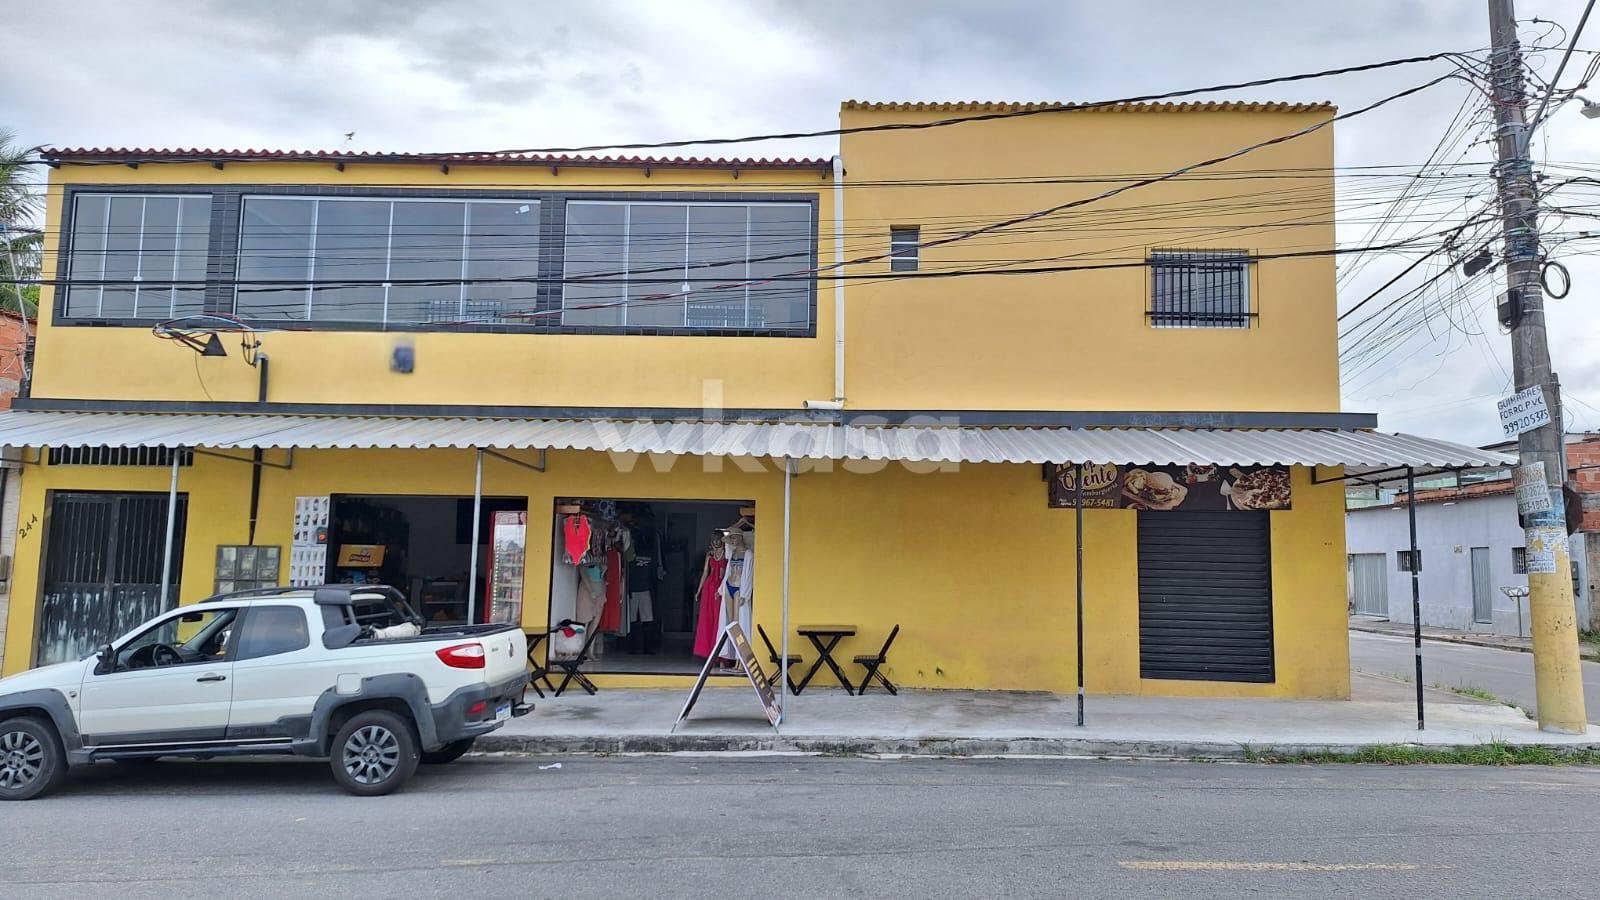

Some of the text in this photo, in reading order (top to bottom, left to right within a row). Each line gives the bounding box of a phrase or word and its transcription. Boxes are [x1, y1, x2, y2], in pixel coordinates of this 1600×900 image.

[1063, 466, 1114, 489] Qente
[1072, 498, 1114, 507] 9967-5481
[19, 513, 38, 539] 244
